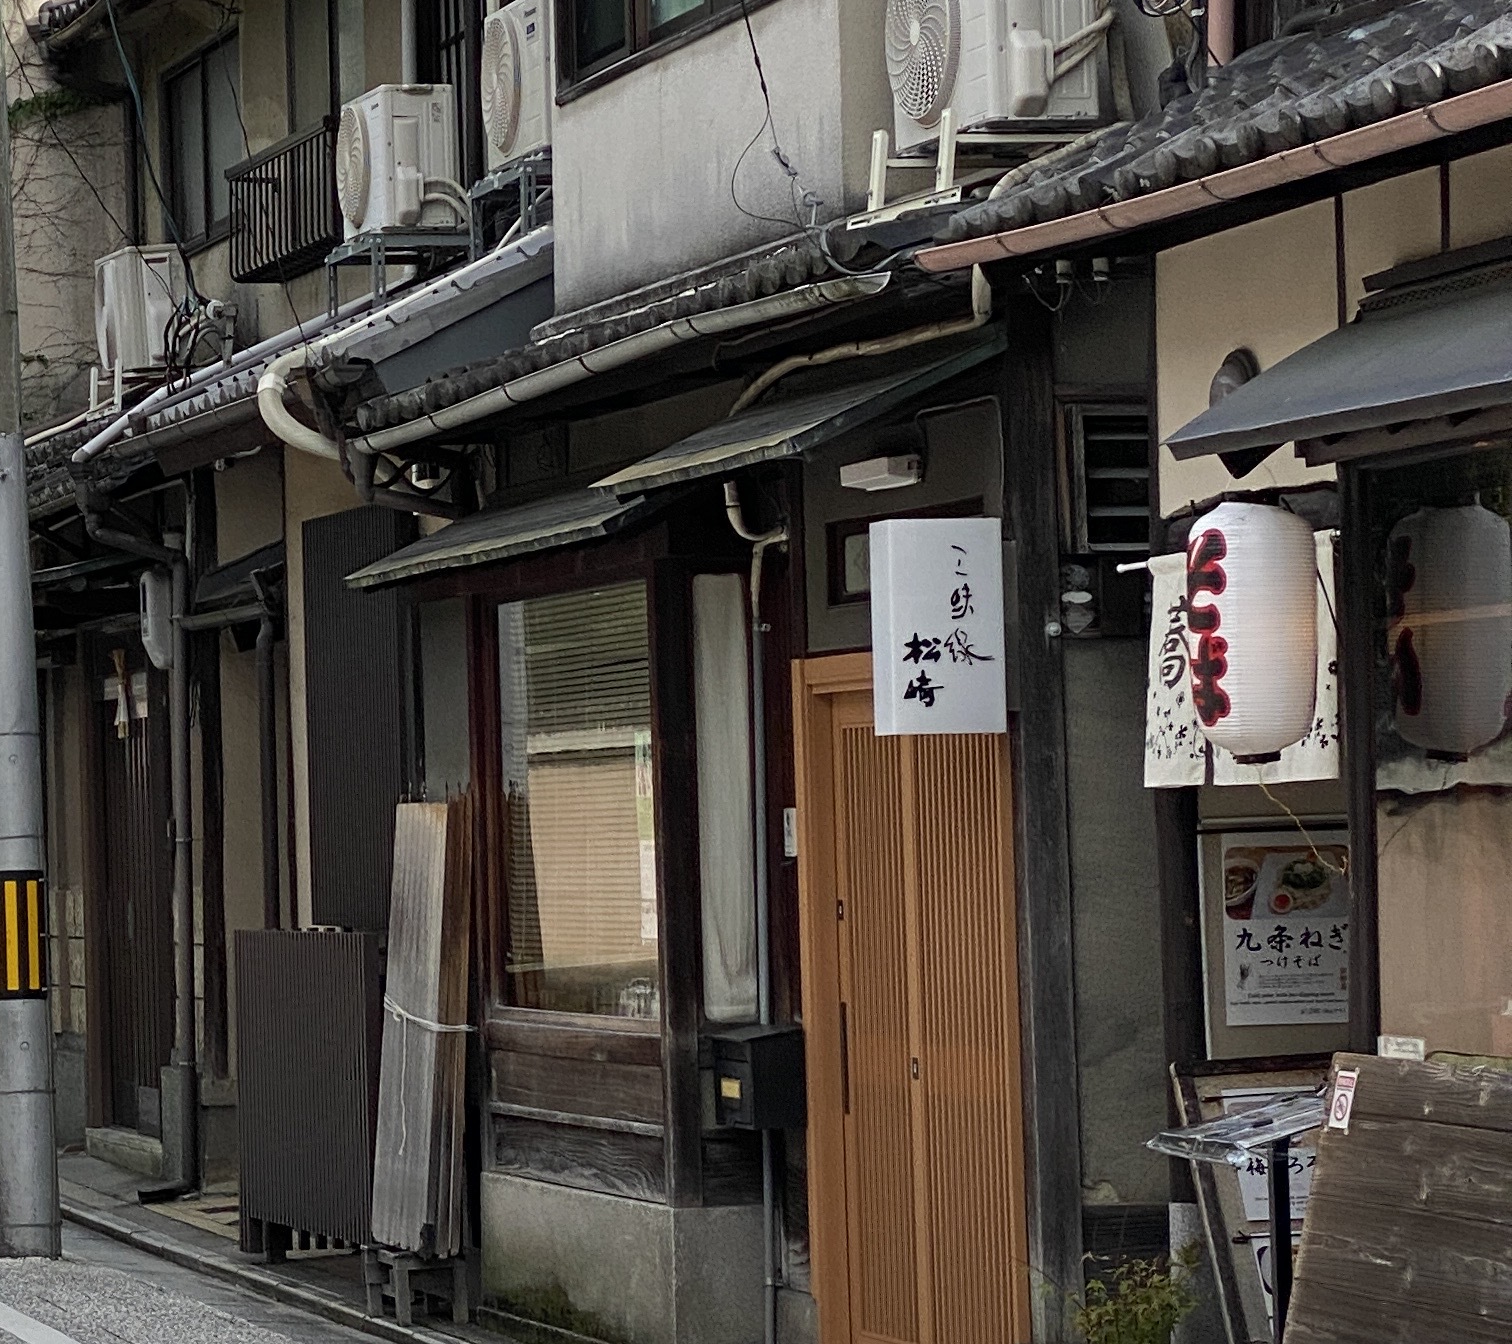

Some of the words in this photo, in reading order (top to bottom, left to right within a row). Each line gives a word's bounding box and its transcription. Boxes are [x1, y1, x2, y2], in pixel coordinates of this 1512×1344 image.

[1235, 924, 1348, 953] 九条ねぎ
[1260, 954, 1322, 969] つけそば
